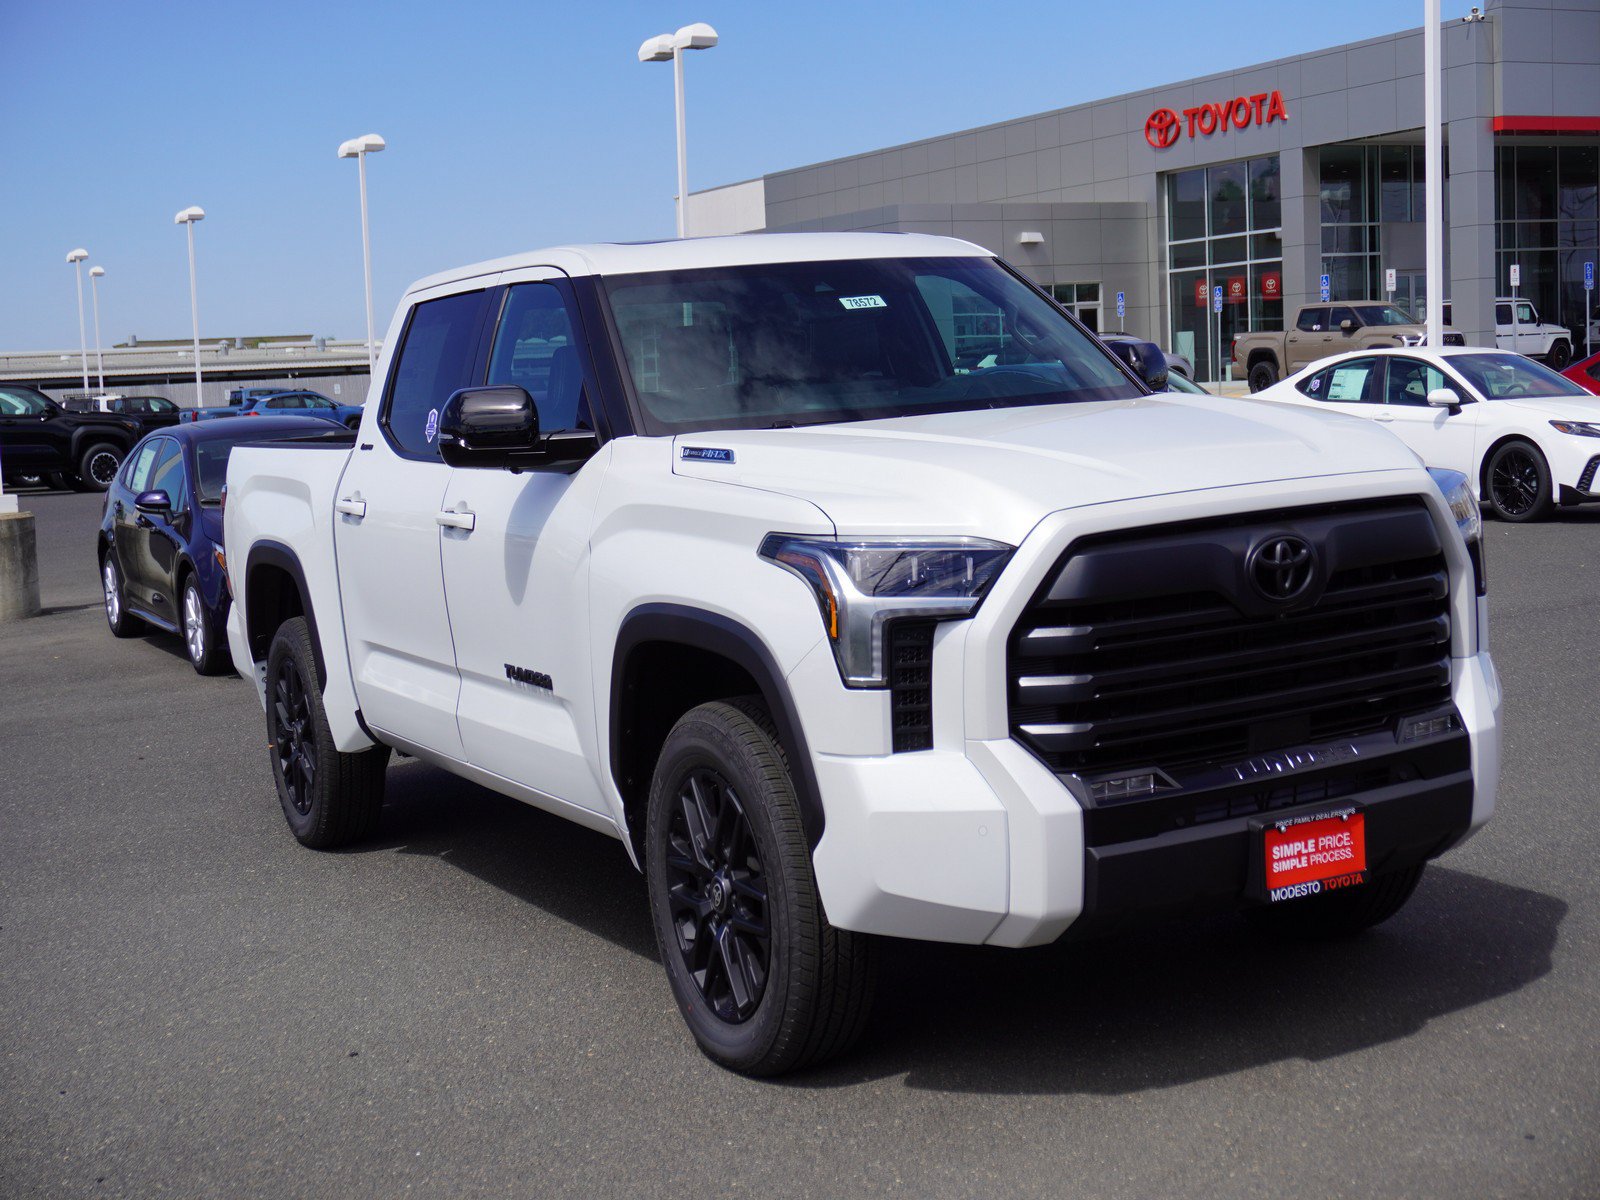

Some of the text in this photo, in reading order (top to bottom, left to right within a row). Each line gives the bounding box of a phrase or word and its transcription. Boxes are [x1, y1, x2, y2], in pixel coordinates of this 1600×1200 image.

[1183, 89, 1288, 138] TOYOTA
[846, 297, 880, 307] 78572
[504, 663, 554, 691] TUNDRA
[1275, 807, 1356, 829] PRICE FAMILY DEALERSHIPS
[1272, 832, 1354, 860] SIMPLE PRICE.
[1272, 848, 1354, 873] SIMPLE PROCESS.
[1271, 873, 1364, 902] MODESTO TOYOTA
